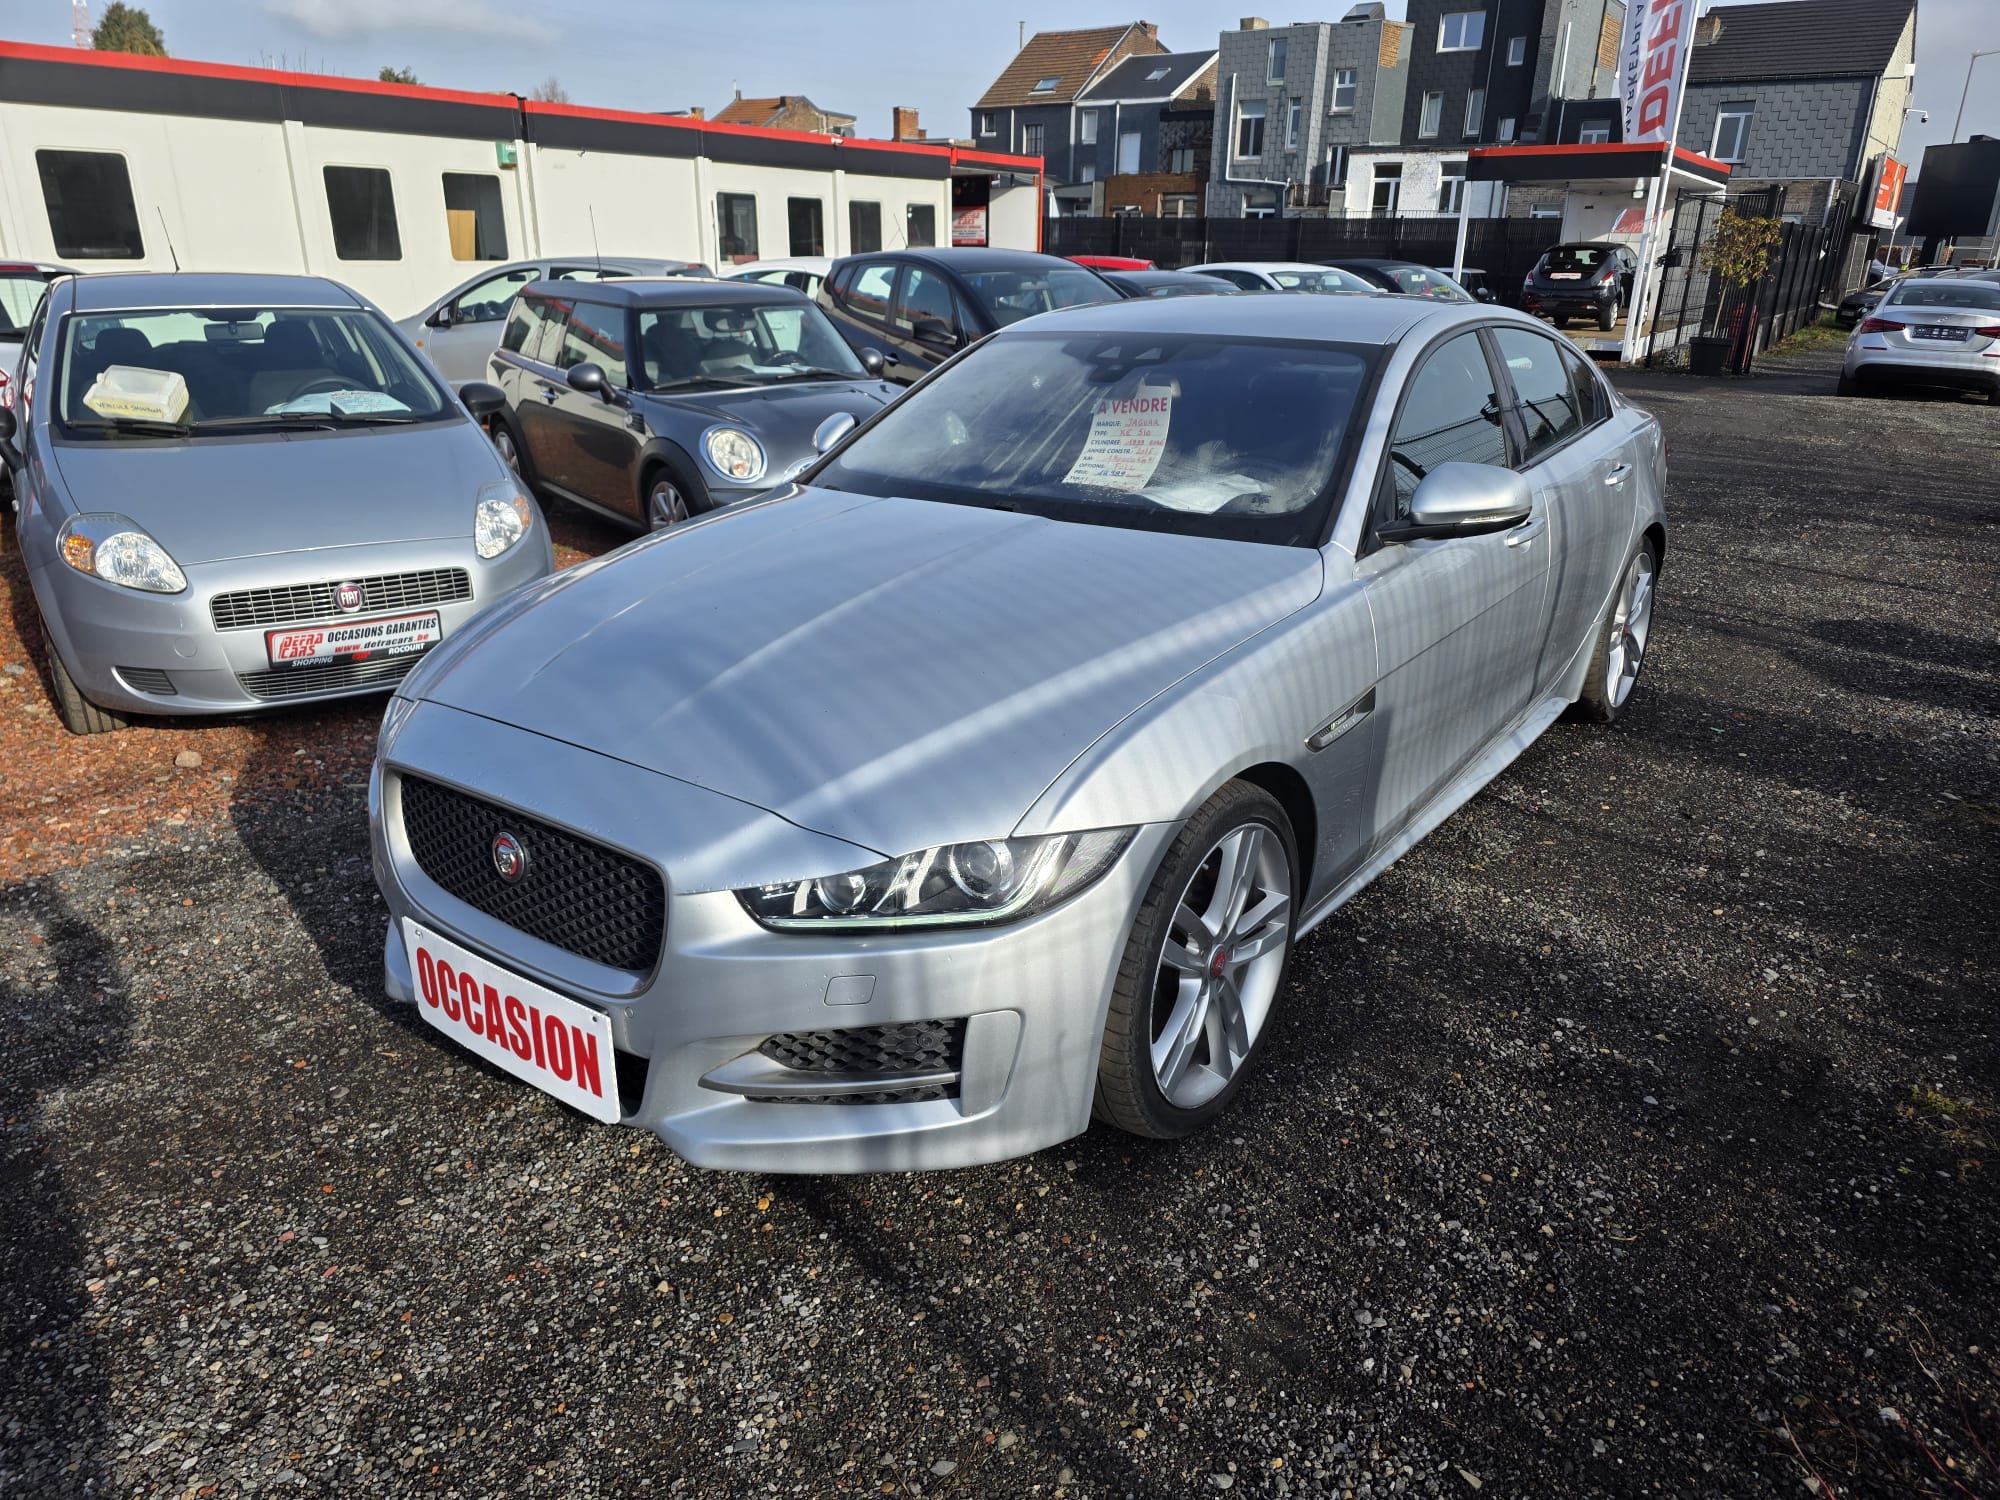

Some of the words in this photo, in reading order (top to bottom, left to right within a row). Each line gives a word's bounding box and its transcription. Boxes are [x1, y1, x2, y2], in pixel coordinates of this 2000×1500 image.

[1112, 397, 1168, 415] VENDRE
[340, 590, 359, 606] FIAT
[327, 626, 384, 643] OCCASIONS
[385, 617, 437, 635] GARANTIES
[280, 632, 324, 649] DEFRA
[278, 645, 316, 660] CARS
[388, 643, 426, 655] ROCOURT
[291, 656, 334, 667] SHOPPING
[416, 946, 603, 1099] OCCASION
